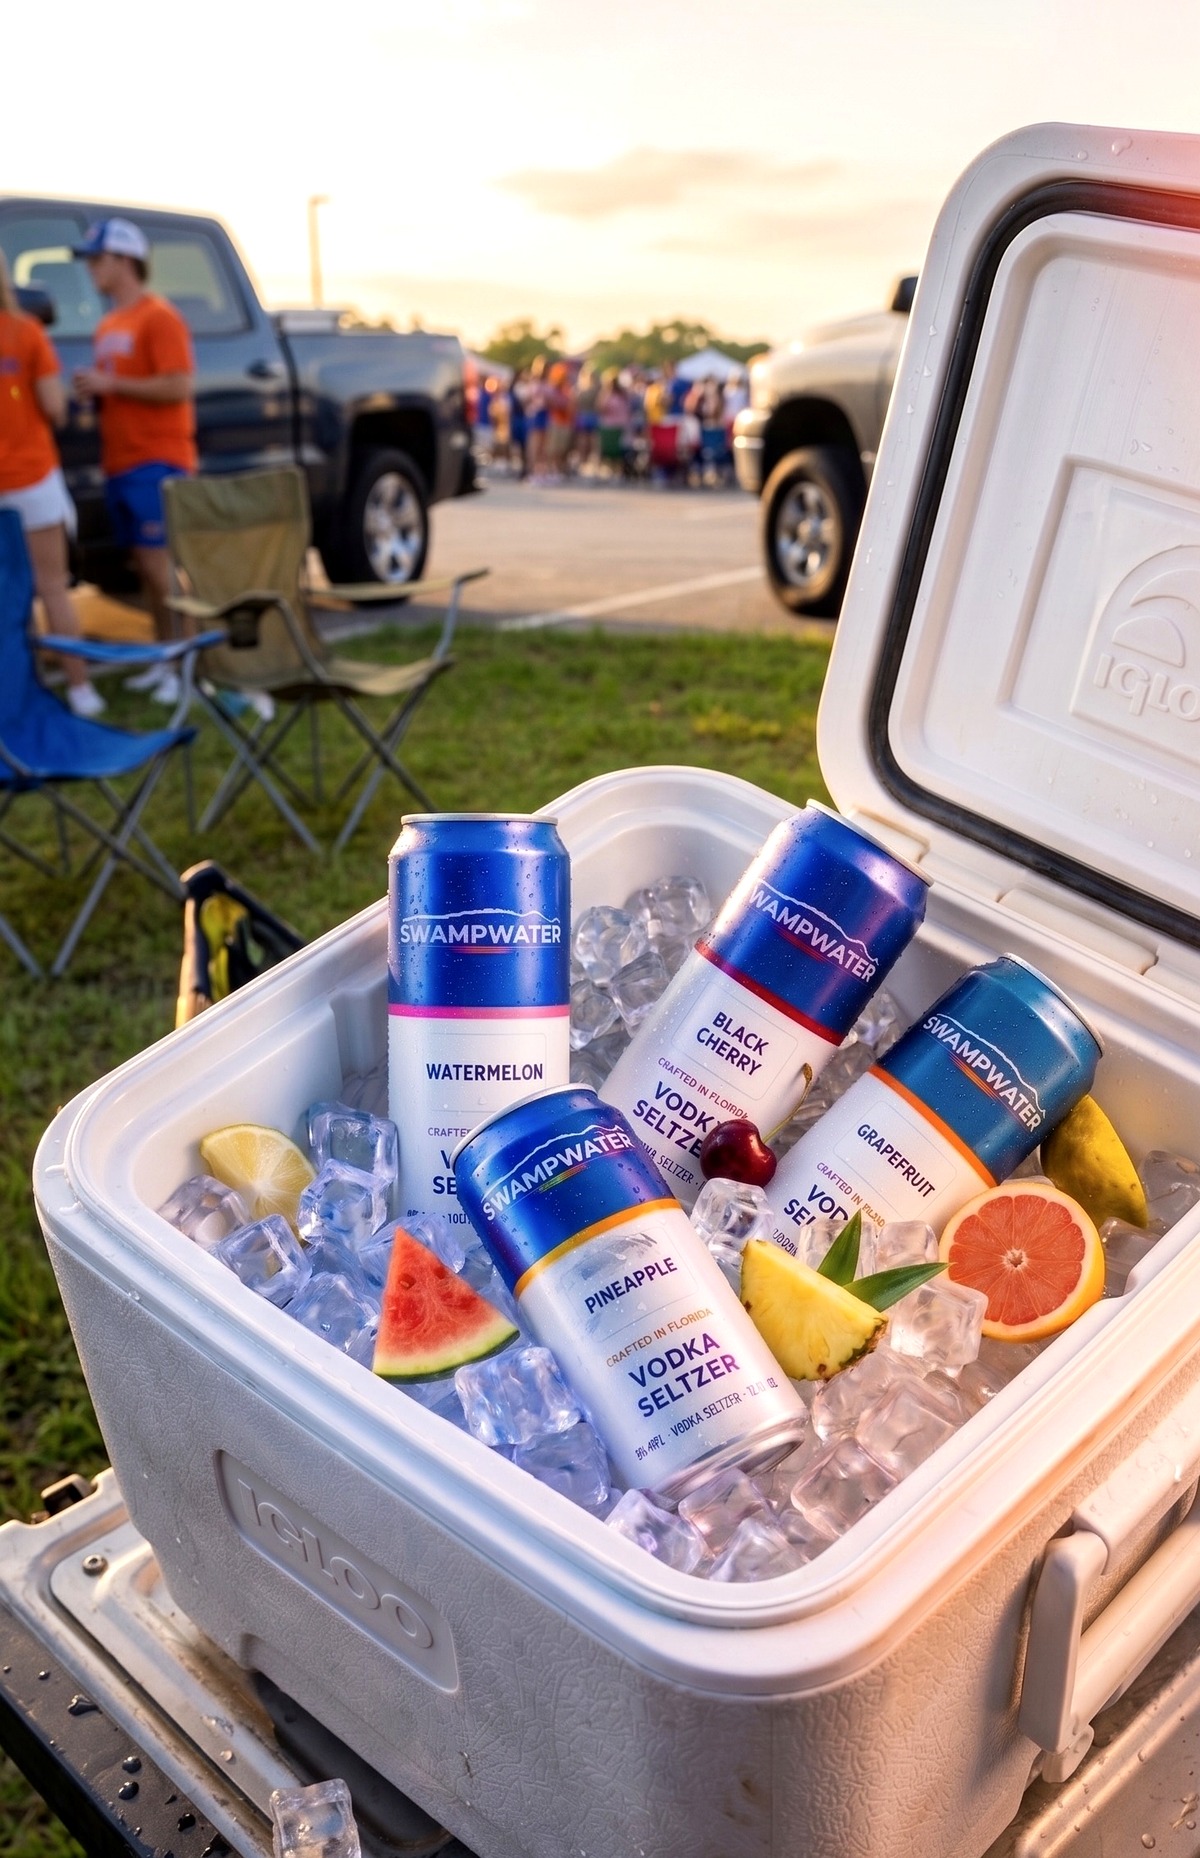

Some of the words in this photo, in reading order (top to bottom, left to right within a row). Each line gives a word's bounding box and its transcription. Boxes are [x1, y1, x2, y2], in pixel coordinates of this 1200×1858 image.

[400, 924, 561, 944] SWAMPWATER
[696, 1027, 762, 1076] CHERRY
[712, 1011, 769, 1056] BLACK
[426, 1063, 543, 1081] WATERMELON
[657, 1057, 697, 1088] CRAFTED
[697, 1084, 710, 1097] IN
[922, 1013, 1041, 1133] SWAMPWATER
[654, 1081, 722, 1133] VODK
[482, 1132, 635, 1221] SWAMPWATER
[657, 1154, 694, 1184] SELTZER
[816, 1162, 853, 1195] CRAFTED
[851, 1193, 863, 1205] IN
[857, 1123, 936, 1198] GRAPEFRUIT
[584, 1257, 678, 1314] PINEAPPLE
[606, 1335, 653, 1368] CRAFTED
[653, 1327, 667, 1340] IN
[667, 1307, 714, 1333] FLORIDA
[628, 1332, 721, 1388] VODKA
[637, 1354, 740, 1418] SELTZER
[670, 1412, 704, 1437] VODKA
